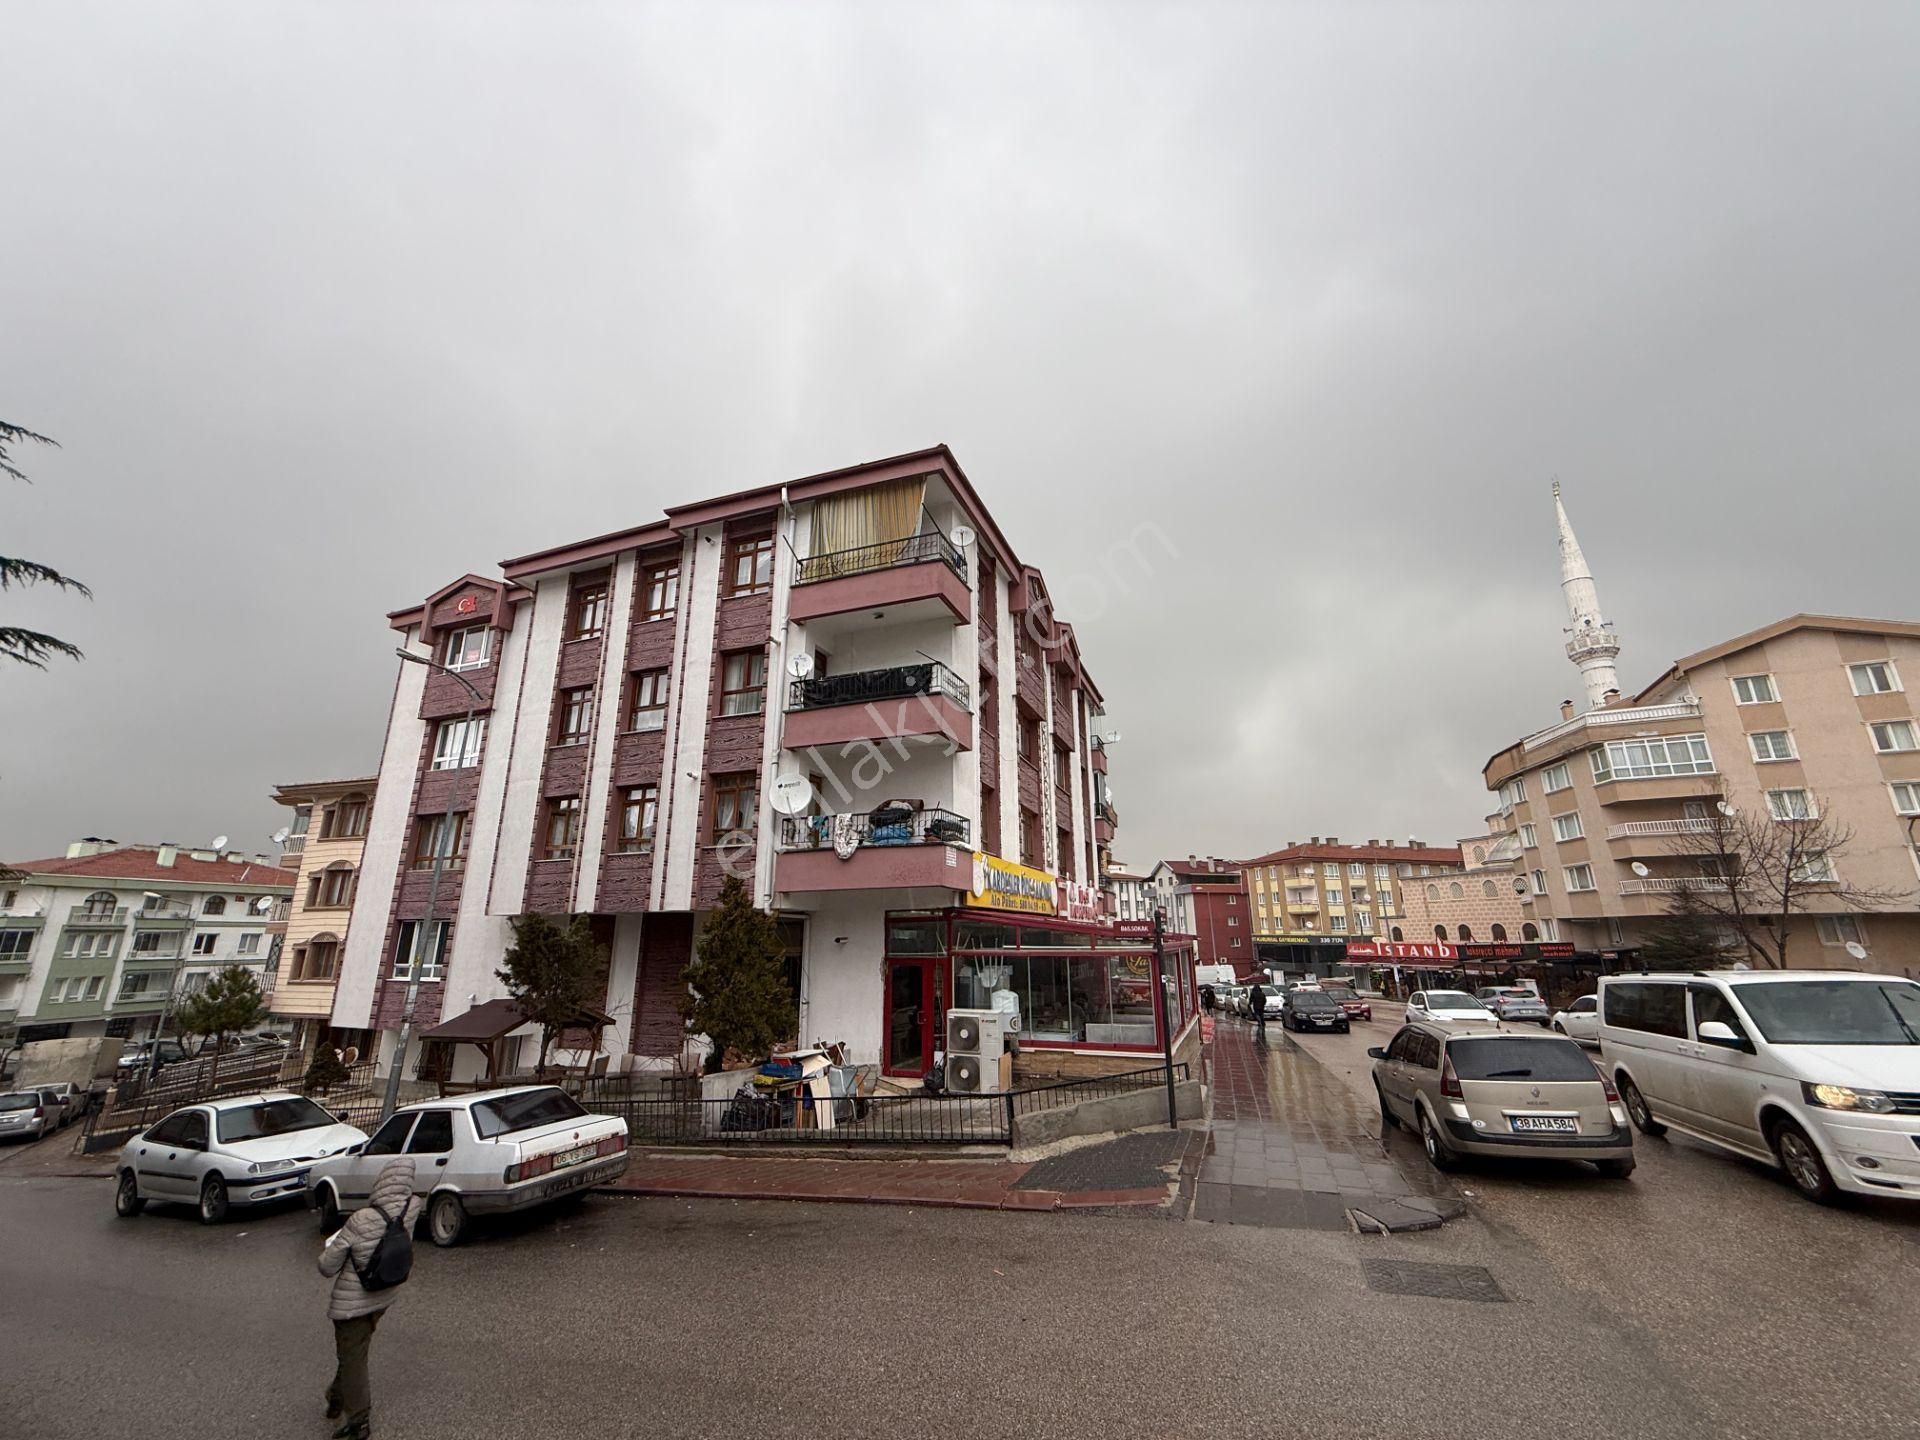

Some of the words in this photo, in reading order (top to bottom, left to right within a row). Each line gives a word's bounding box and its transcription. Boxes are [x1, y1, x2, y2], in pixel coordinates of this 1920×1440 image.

[1517, 1118, 1530, 1129] 38
[1532, 1118, 1553, 1129] AHA
[1553, 1119, 1574, 1130] 584
